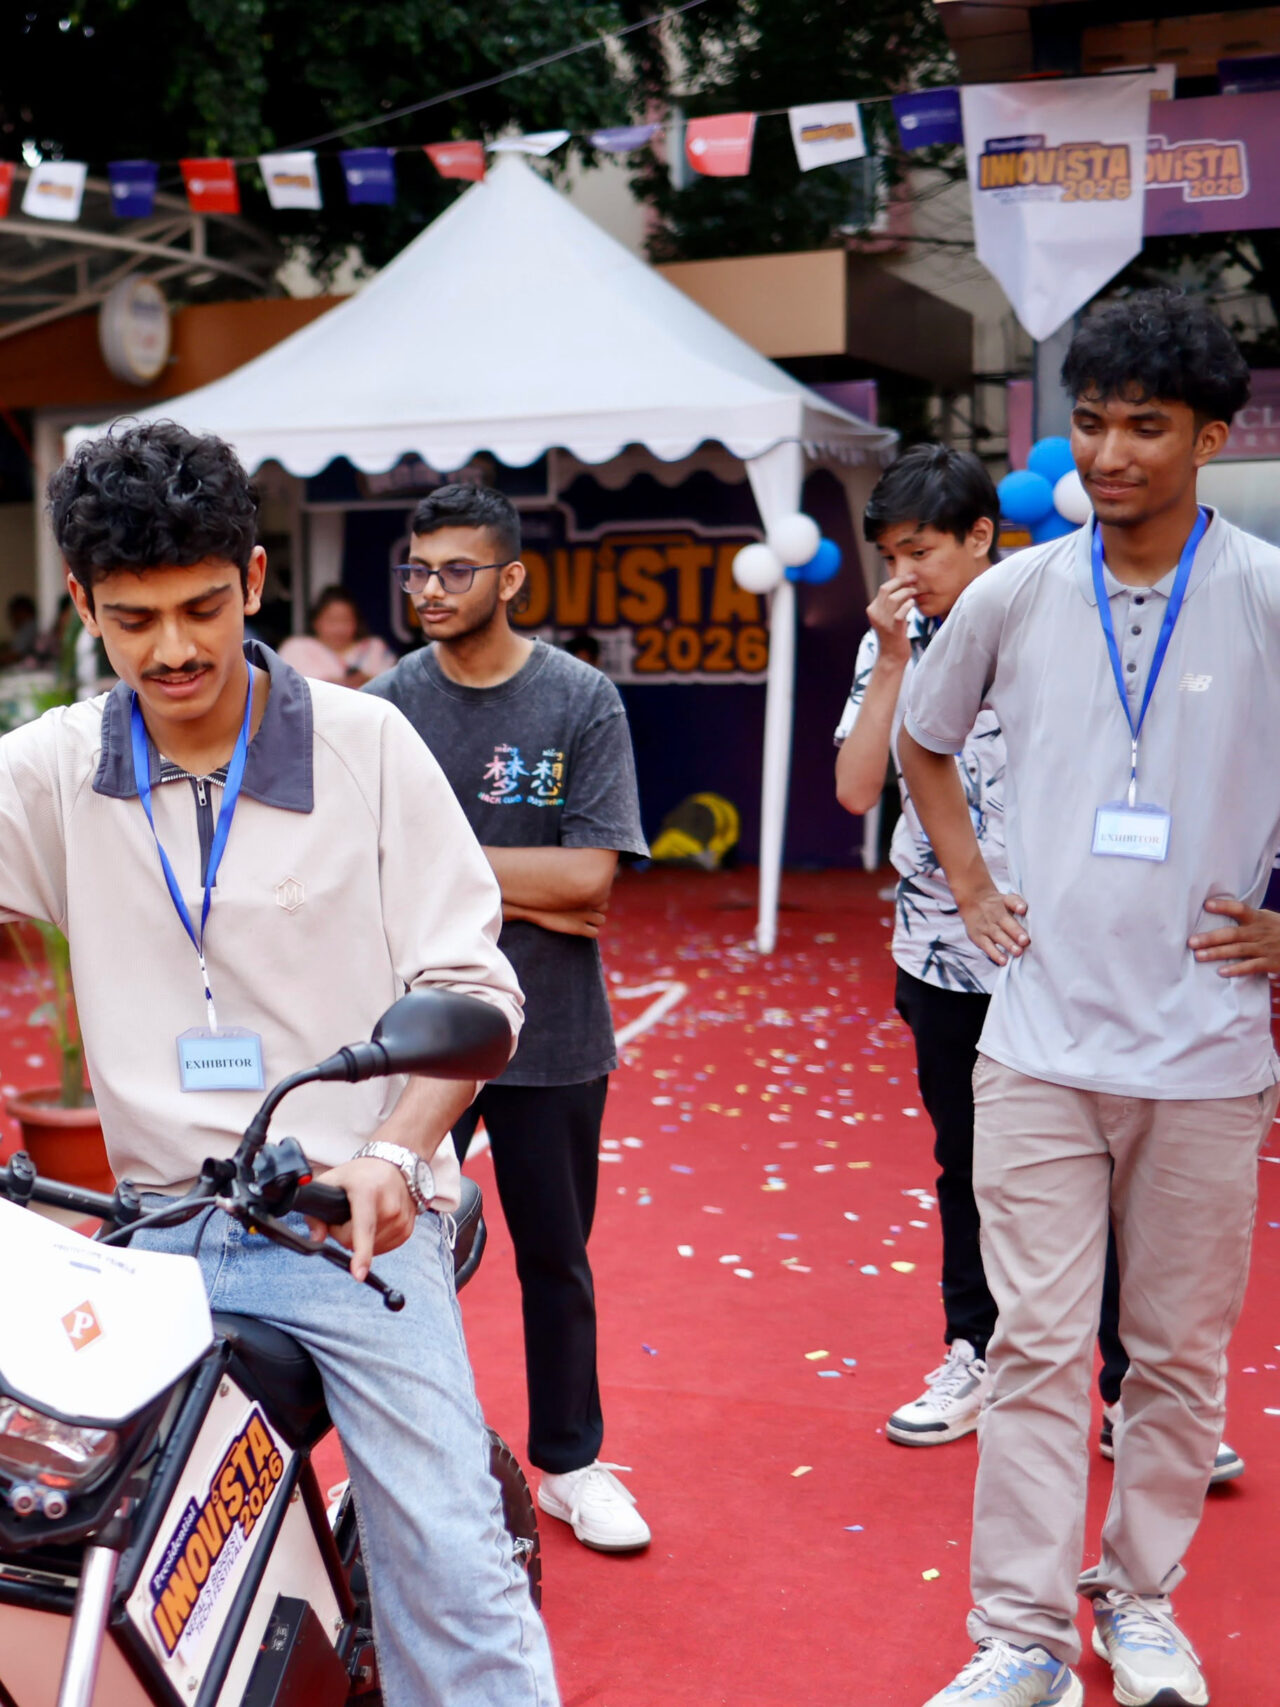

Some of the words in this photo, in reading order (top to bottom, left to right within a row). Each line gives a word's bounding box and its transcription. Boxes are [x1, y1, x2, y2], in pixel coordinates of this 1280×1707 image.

[1062, 180, 1131, 201] 2026
[1189, 179, 1243, 198] 2026
[635, 628, 767, 672] 2026
[185, 1058, 252, 1070] EXHIBITOR
[239, 1452, 283, 1534] 2026
[153, 1505, 198, 1591] Presidential
